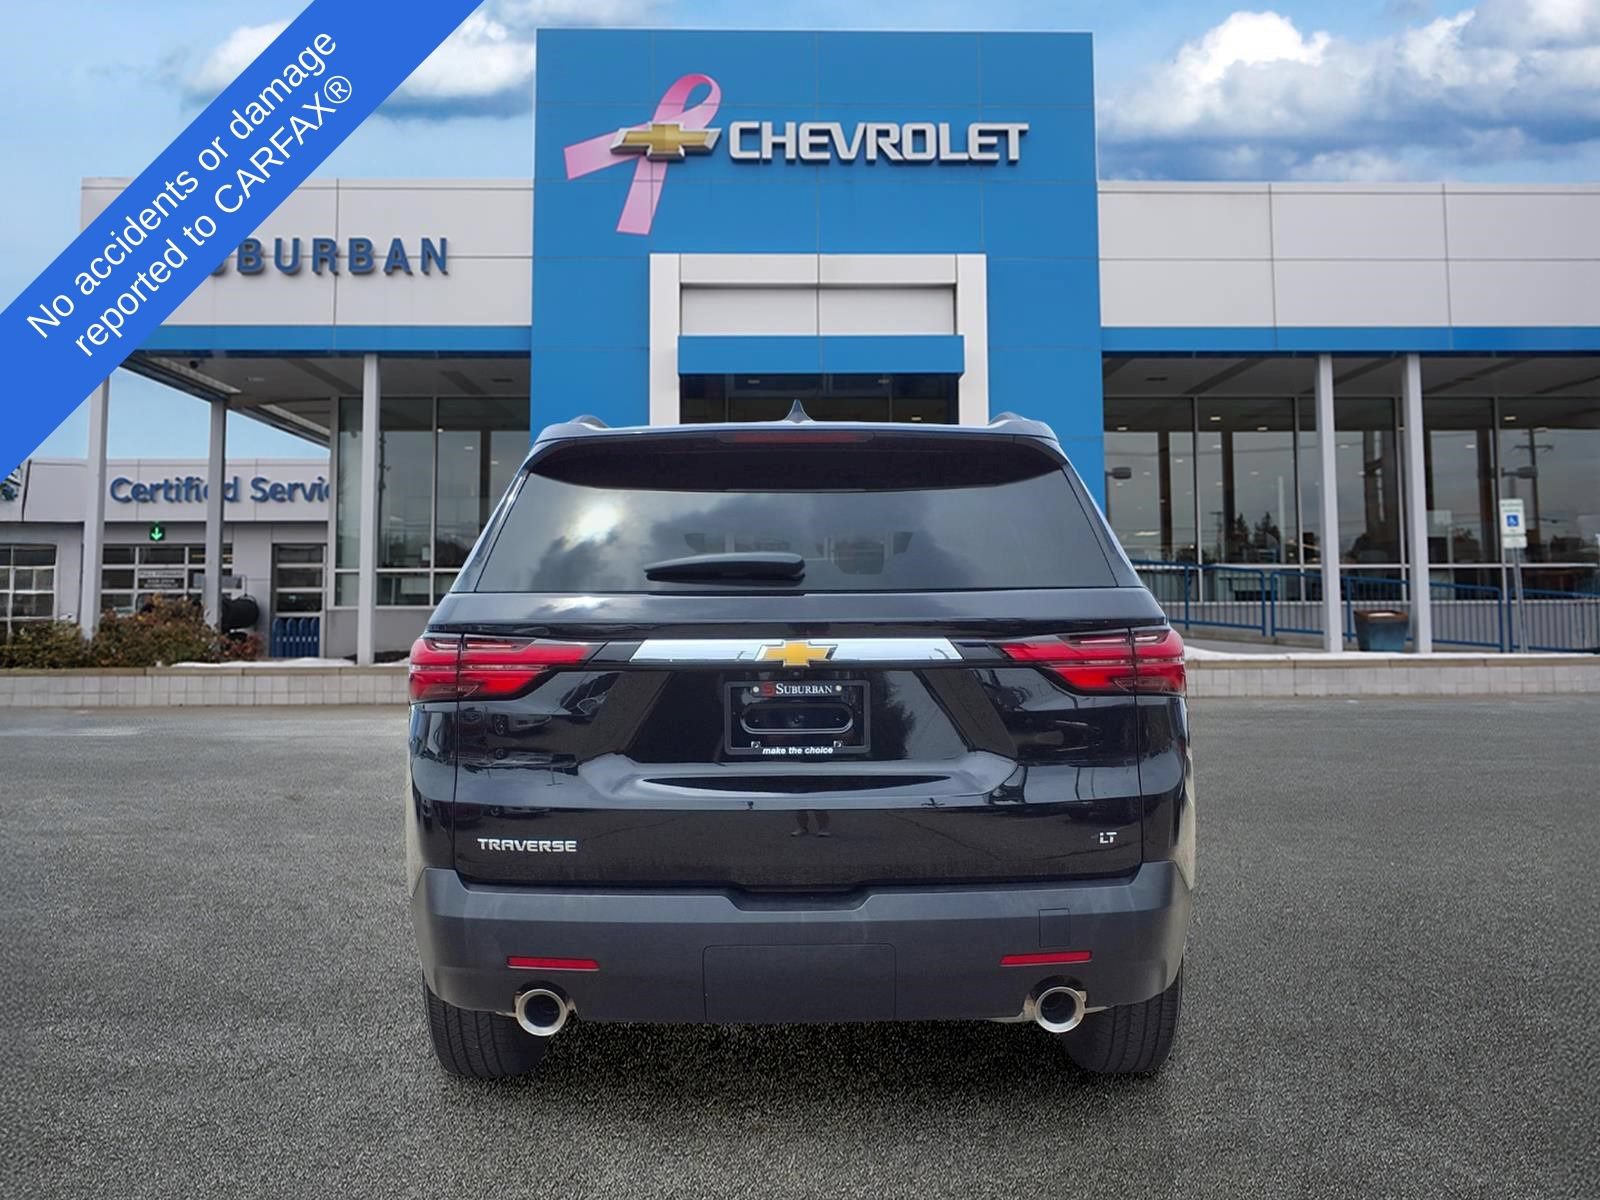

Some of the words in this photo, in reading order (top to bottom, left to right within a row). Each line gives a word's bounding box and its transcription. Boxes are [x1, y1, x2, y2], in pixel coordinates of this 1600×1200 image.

[728, 121, 1030, 163] CHEVROLET
[211, 237, 449, 277] BURBAN
[110, 475, 240, 503] Certifid
[250, 475, 330, 503] Servi
[762, 746, 787, 754] make
[788, 746, 803, 754] the
[804, 746, 834, 754] choice
[477, 838, 577, 852] TRAVERSE
[1099, 831, 1118, 844] LT
